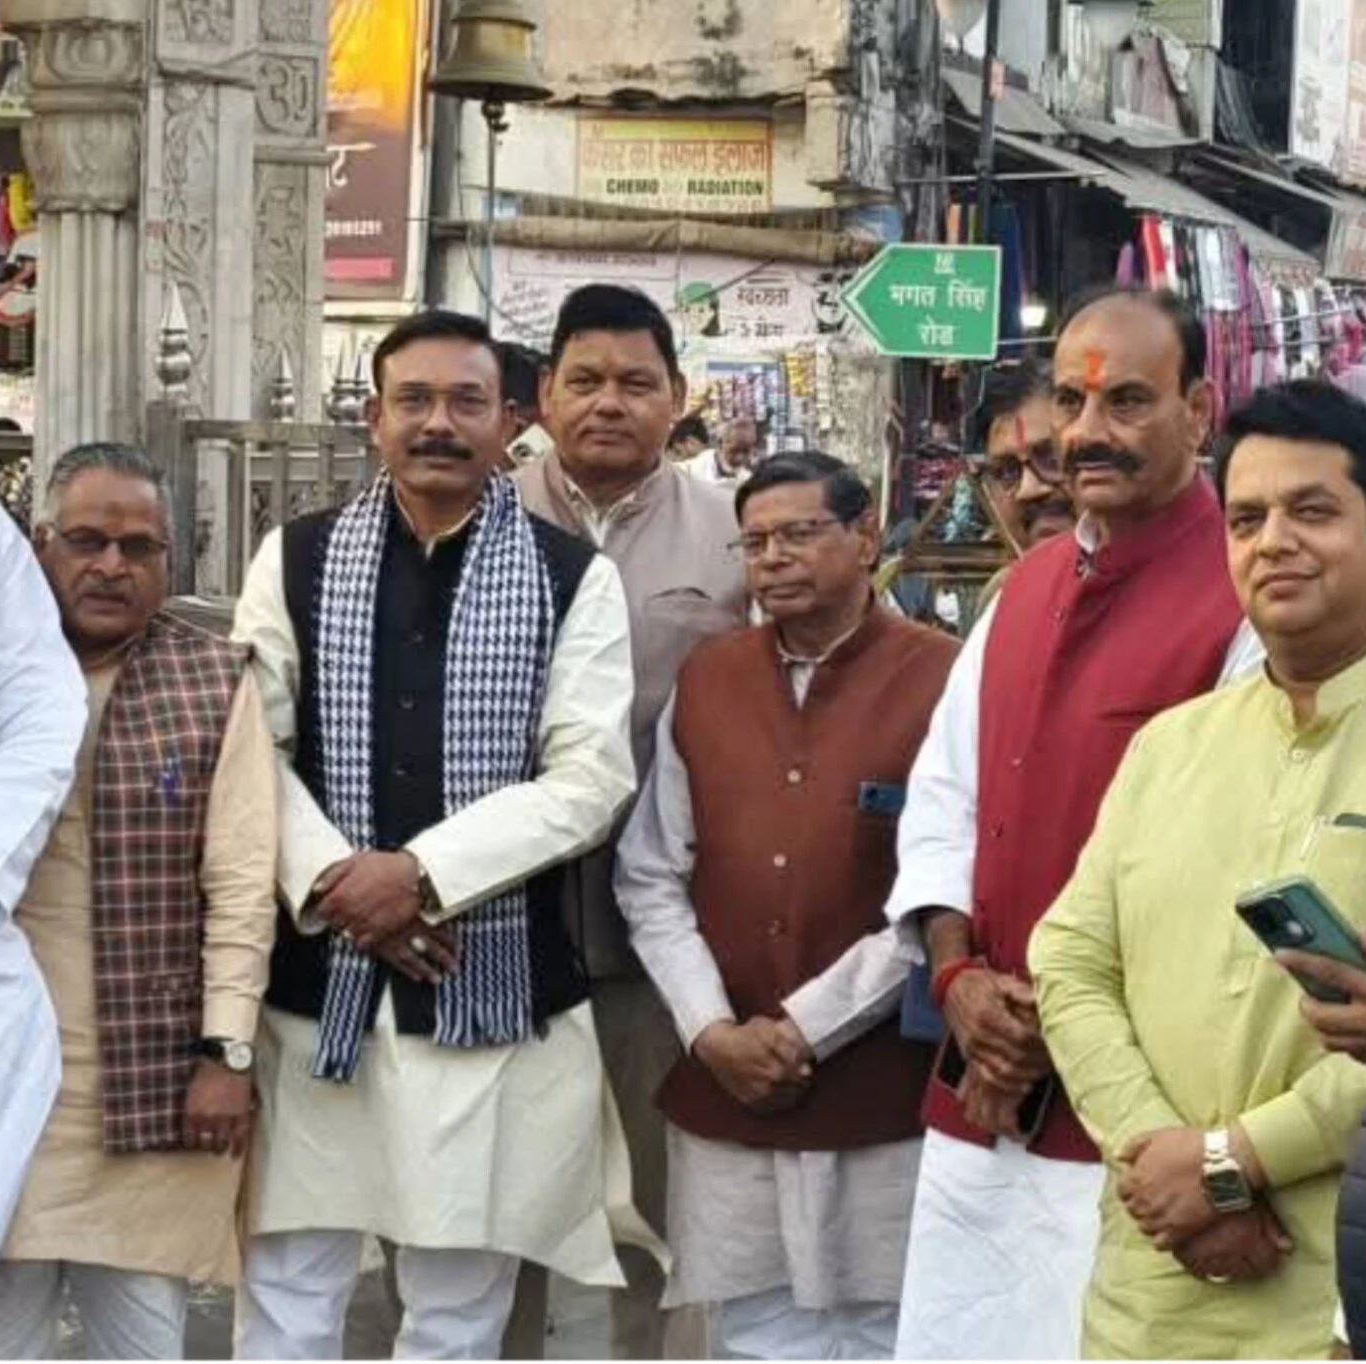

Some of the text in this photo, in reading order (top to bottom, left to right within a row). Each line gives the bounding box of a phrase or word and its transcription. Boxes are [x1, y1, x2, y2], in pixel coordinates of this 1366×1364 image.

[606, 178, 764, 195] CHEMO RADIATION
[889, 279, 989, 313] भगत सिंह
[919, 314, 957, 346] रोड
